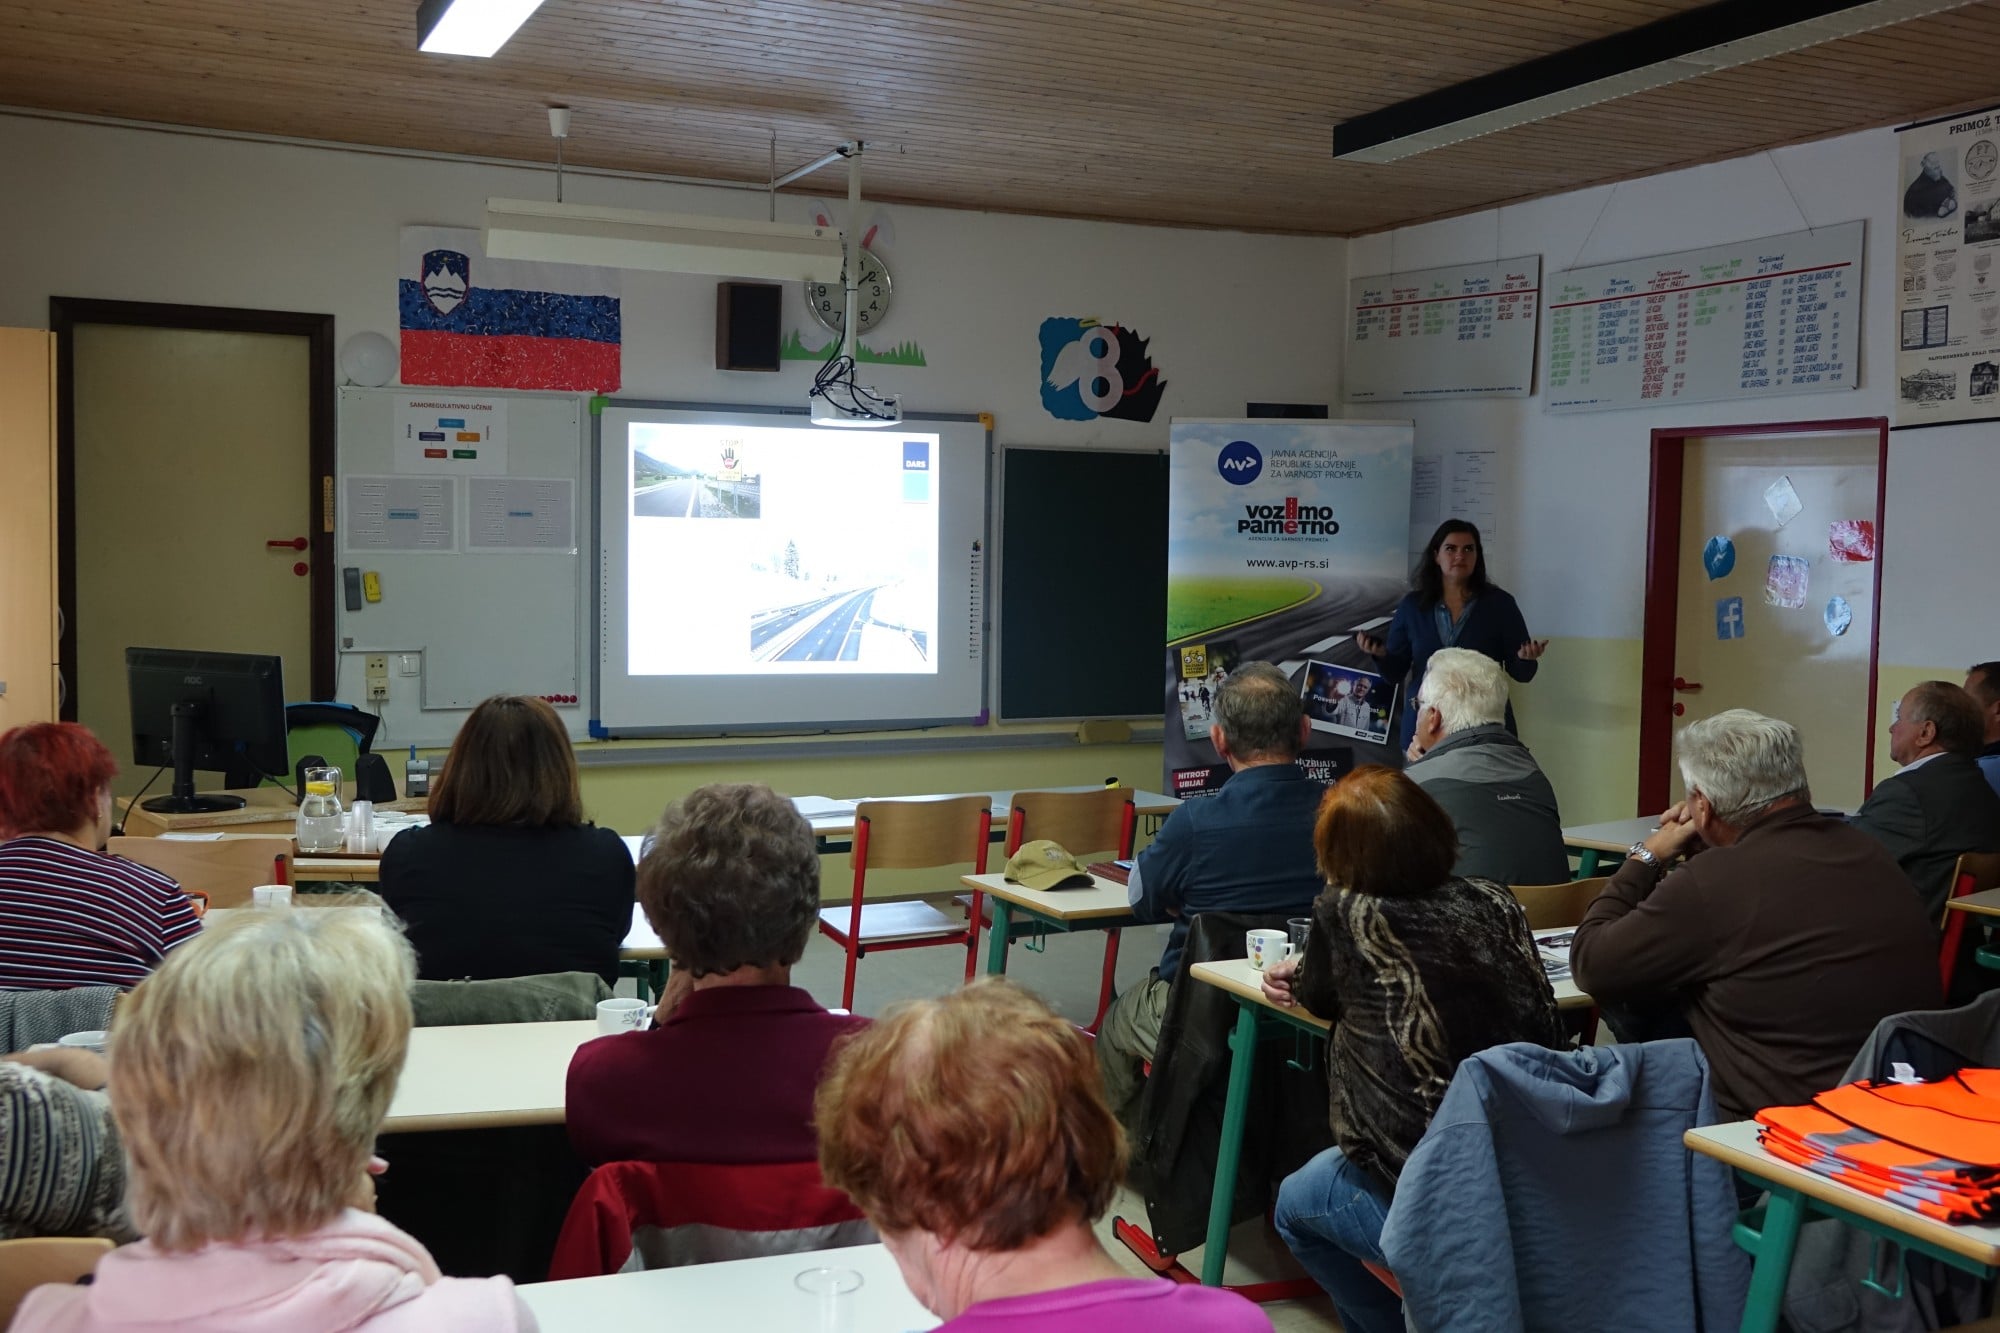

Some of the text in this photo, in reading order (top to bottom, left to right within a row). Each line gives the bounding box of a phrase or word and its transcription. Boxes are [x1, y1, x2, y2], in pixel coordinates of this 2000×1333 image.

[1948, 116, 1991, 135] PRIMOŽ
[859, 260, 865, 271] 1
[868, 271, 877, 282] 2
[817, 285, 827, 297] 9
[872, 285, 881, 297] 3
[822, 300, 831, 312] 8
[869, 300, 878, 311] 4
[834, 311, 842, 322] 7
[860, 311, 869, 322] 5
[409, 401, 493, 411] SAMOREGULATIVNO UČENJE
[1270, 449, 1338, 459] JAVNA AGENCIJA
[905, 459, 926, 469] DARS
[1270, 459, 1357, 469] REPUBLIKE SLOVENIJE
[1270, 469, 1363, 479] ZA VARNOST PROMETA
[1246, 558, 1329, 571] www.avp-rs.si
